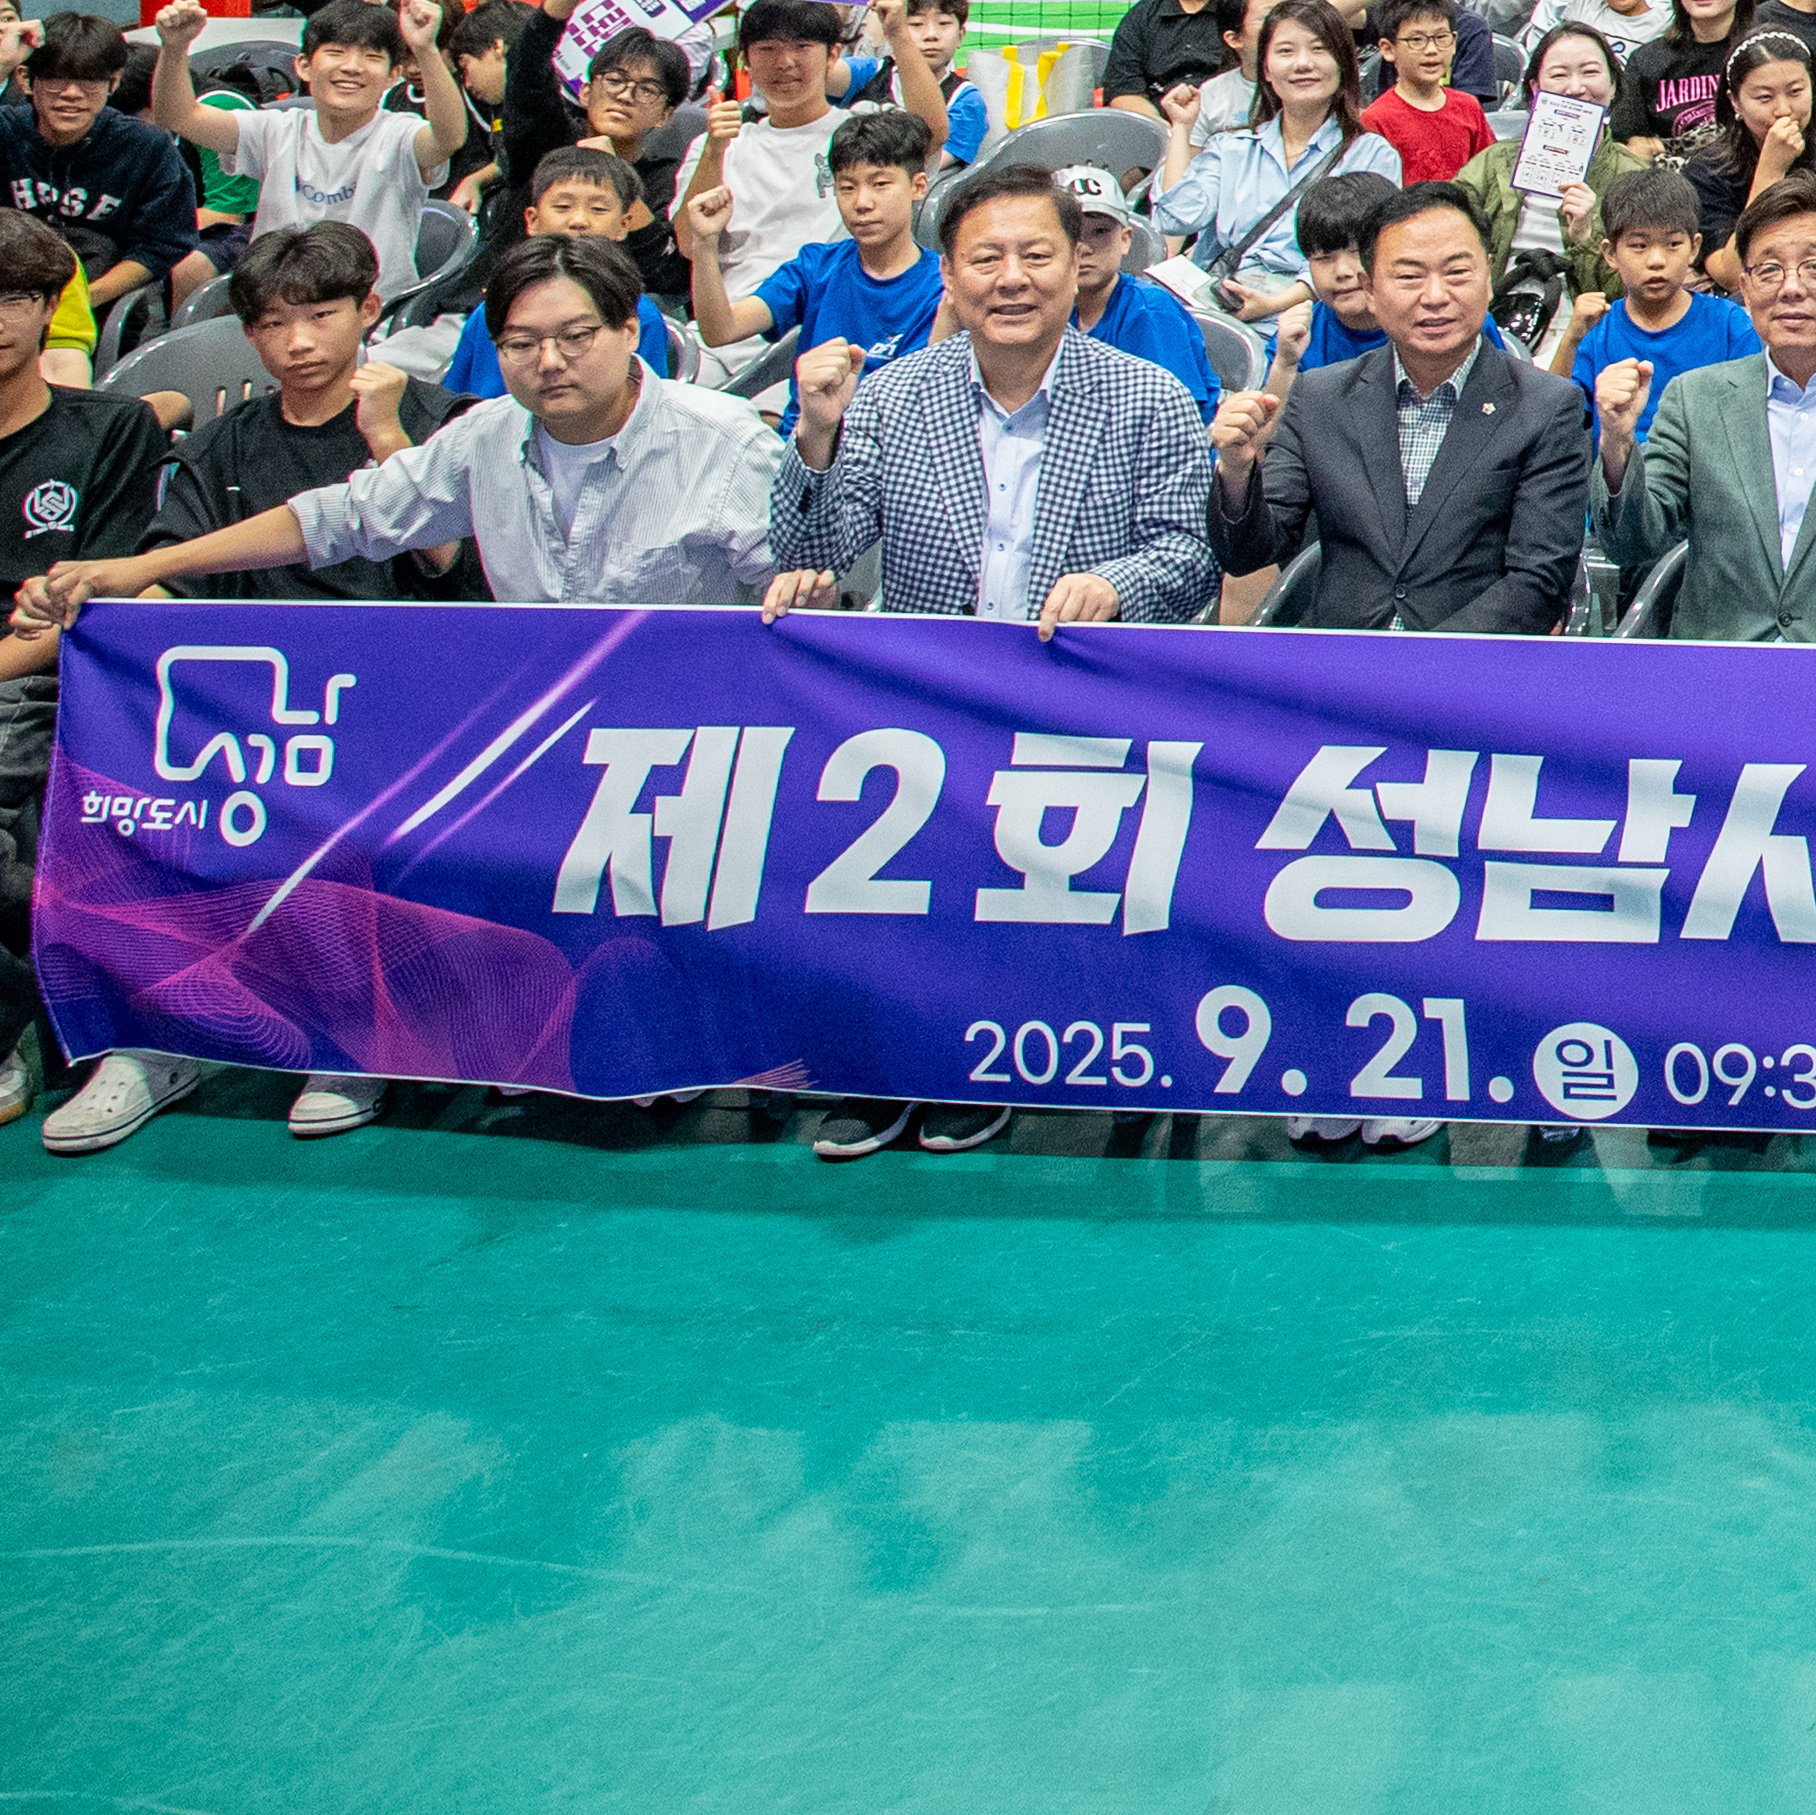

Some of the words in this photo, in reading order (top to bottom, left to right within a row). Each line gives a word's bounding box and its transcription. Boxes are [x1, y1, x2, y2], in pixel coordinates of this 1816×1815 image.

[79, 790, 209, 836] 희망도시
[551, 725, 1205, 936] 제2회
[965, 1019, 1175, 1090] 2025.
